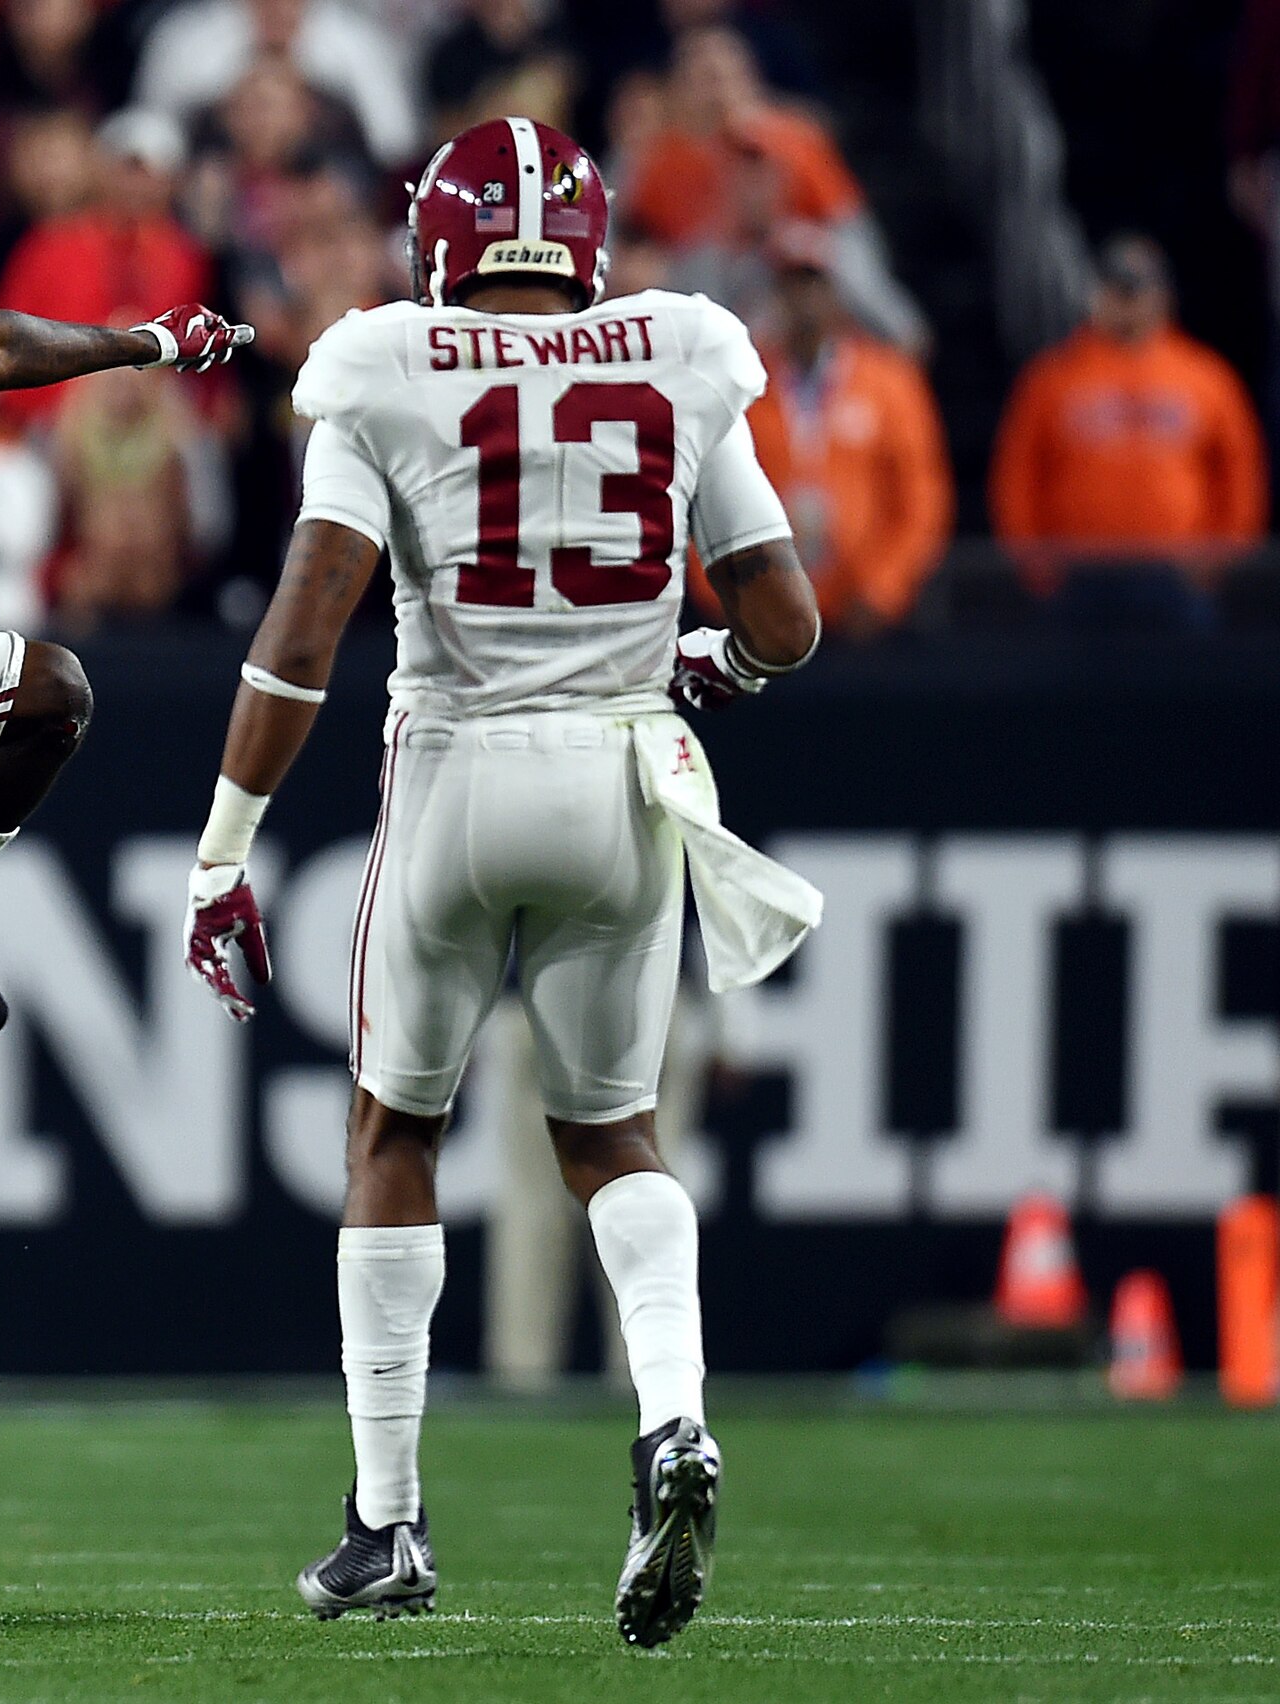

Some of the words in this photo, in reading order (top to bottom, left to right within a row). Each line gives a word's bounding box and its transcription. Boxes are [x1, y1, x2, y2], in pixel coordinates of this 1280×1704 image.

[483, 182, 505, 202] 28
[492, 247, 563, 264] schutt
[428, 316, 654, 371] STEWART
[455, 381, 676, 607] 13
[672, 736, 696, 776] A
